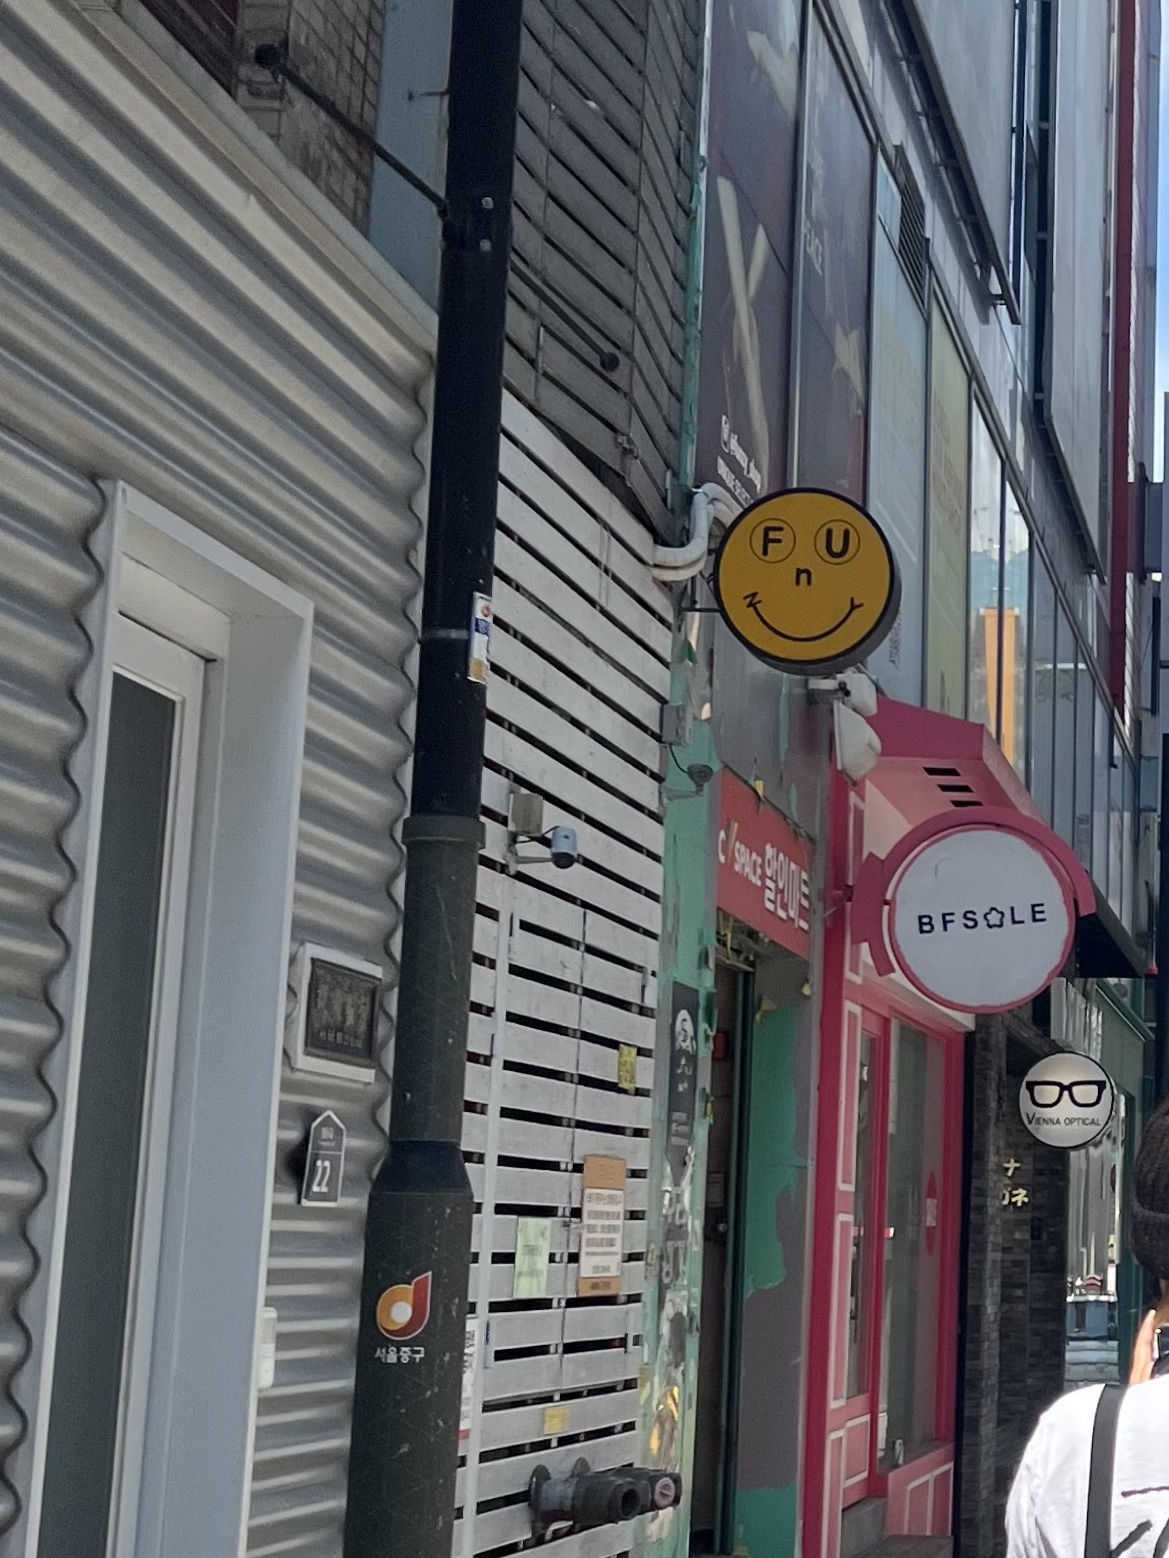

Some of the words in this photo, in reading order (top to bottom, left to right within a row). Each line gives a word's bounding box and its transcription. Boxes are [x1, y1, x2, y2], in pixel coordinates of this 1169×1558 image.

[734, 841, 763, 887] SPACE
[764, 842, 810, 931] 할인마트
[1063, 1117, 1102, 1127] OPTICAL
[312, 1160, 331, 1193] 22
[374, 1346, 426, 1364] 서울중구
